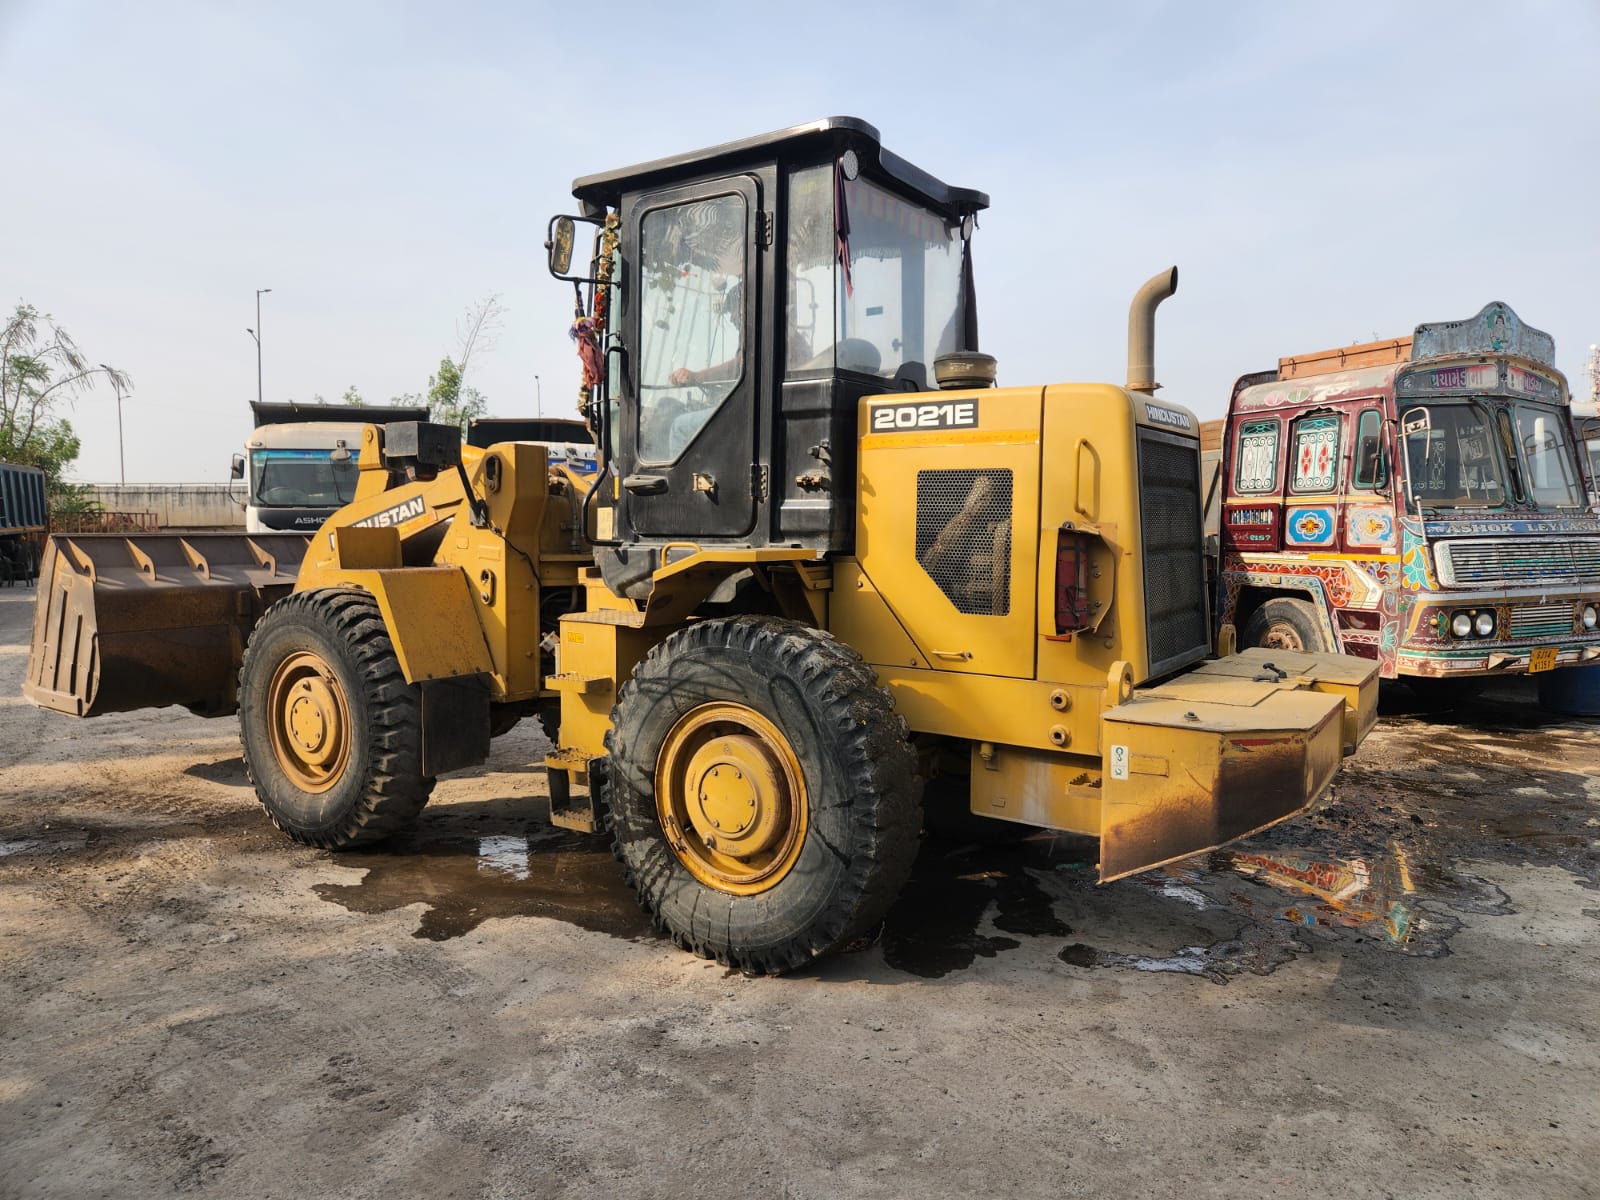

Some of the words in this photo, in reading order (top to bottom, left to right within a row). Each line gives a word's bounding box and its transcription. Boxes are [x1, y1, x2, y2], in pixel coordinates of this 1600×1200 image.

[874, 403, 974, 429] 2021E
[1146, 405, 1190, 428] HINDUSTAN
[294, 517, 328, 525] ASHO
[1446, 522, 1515, 533] ASHOK
